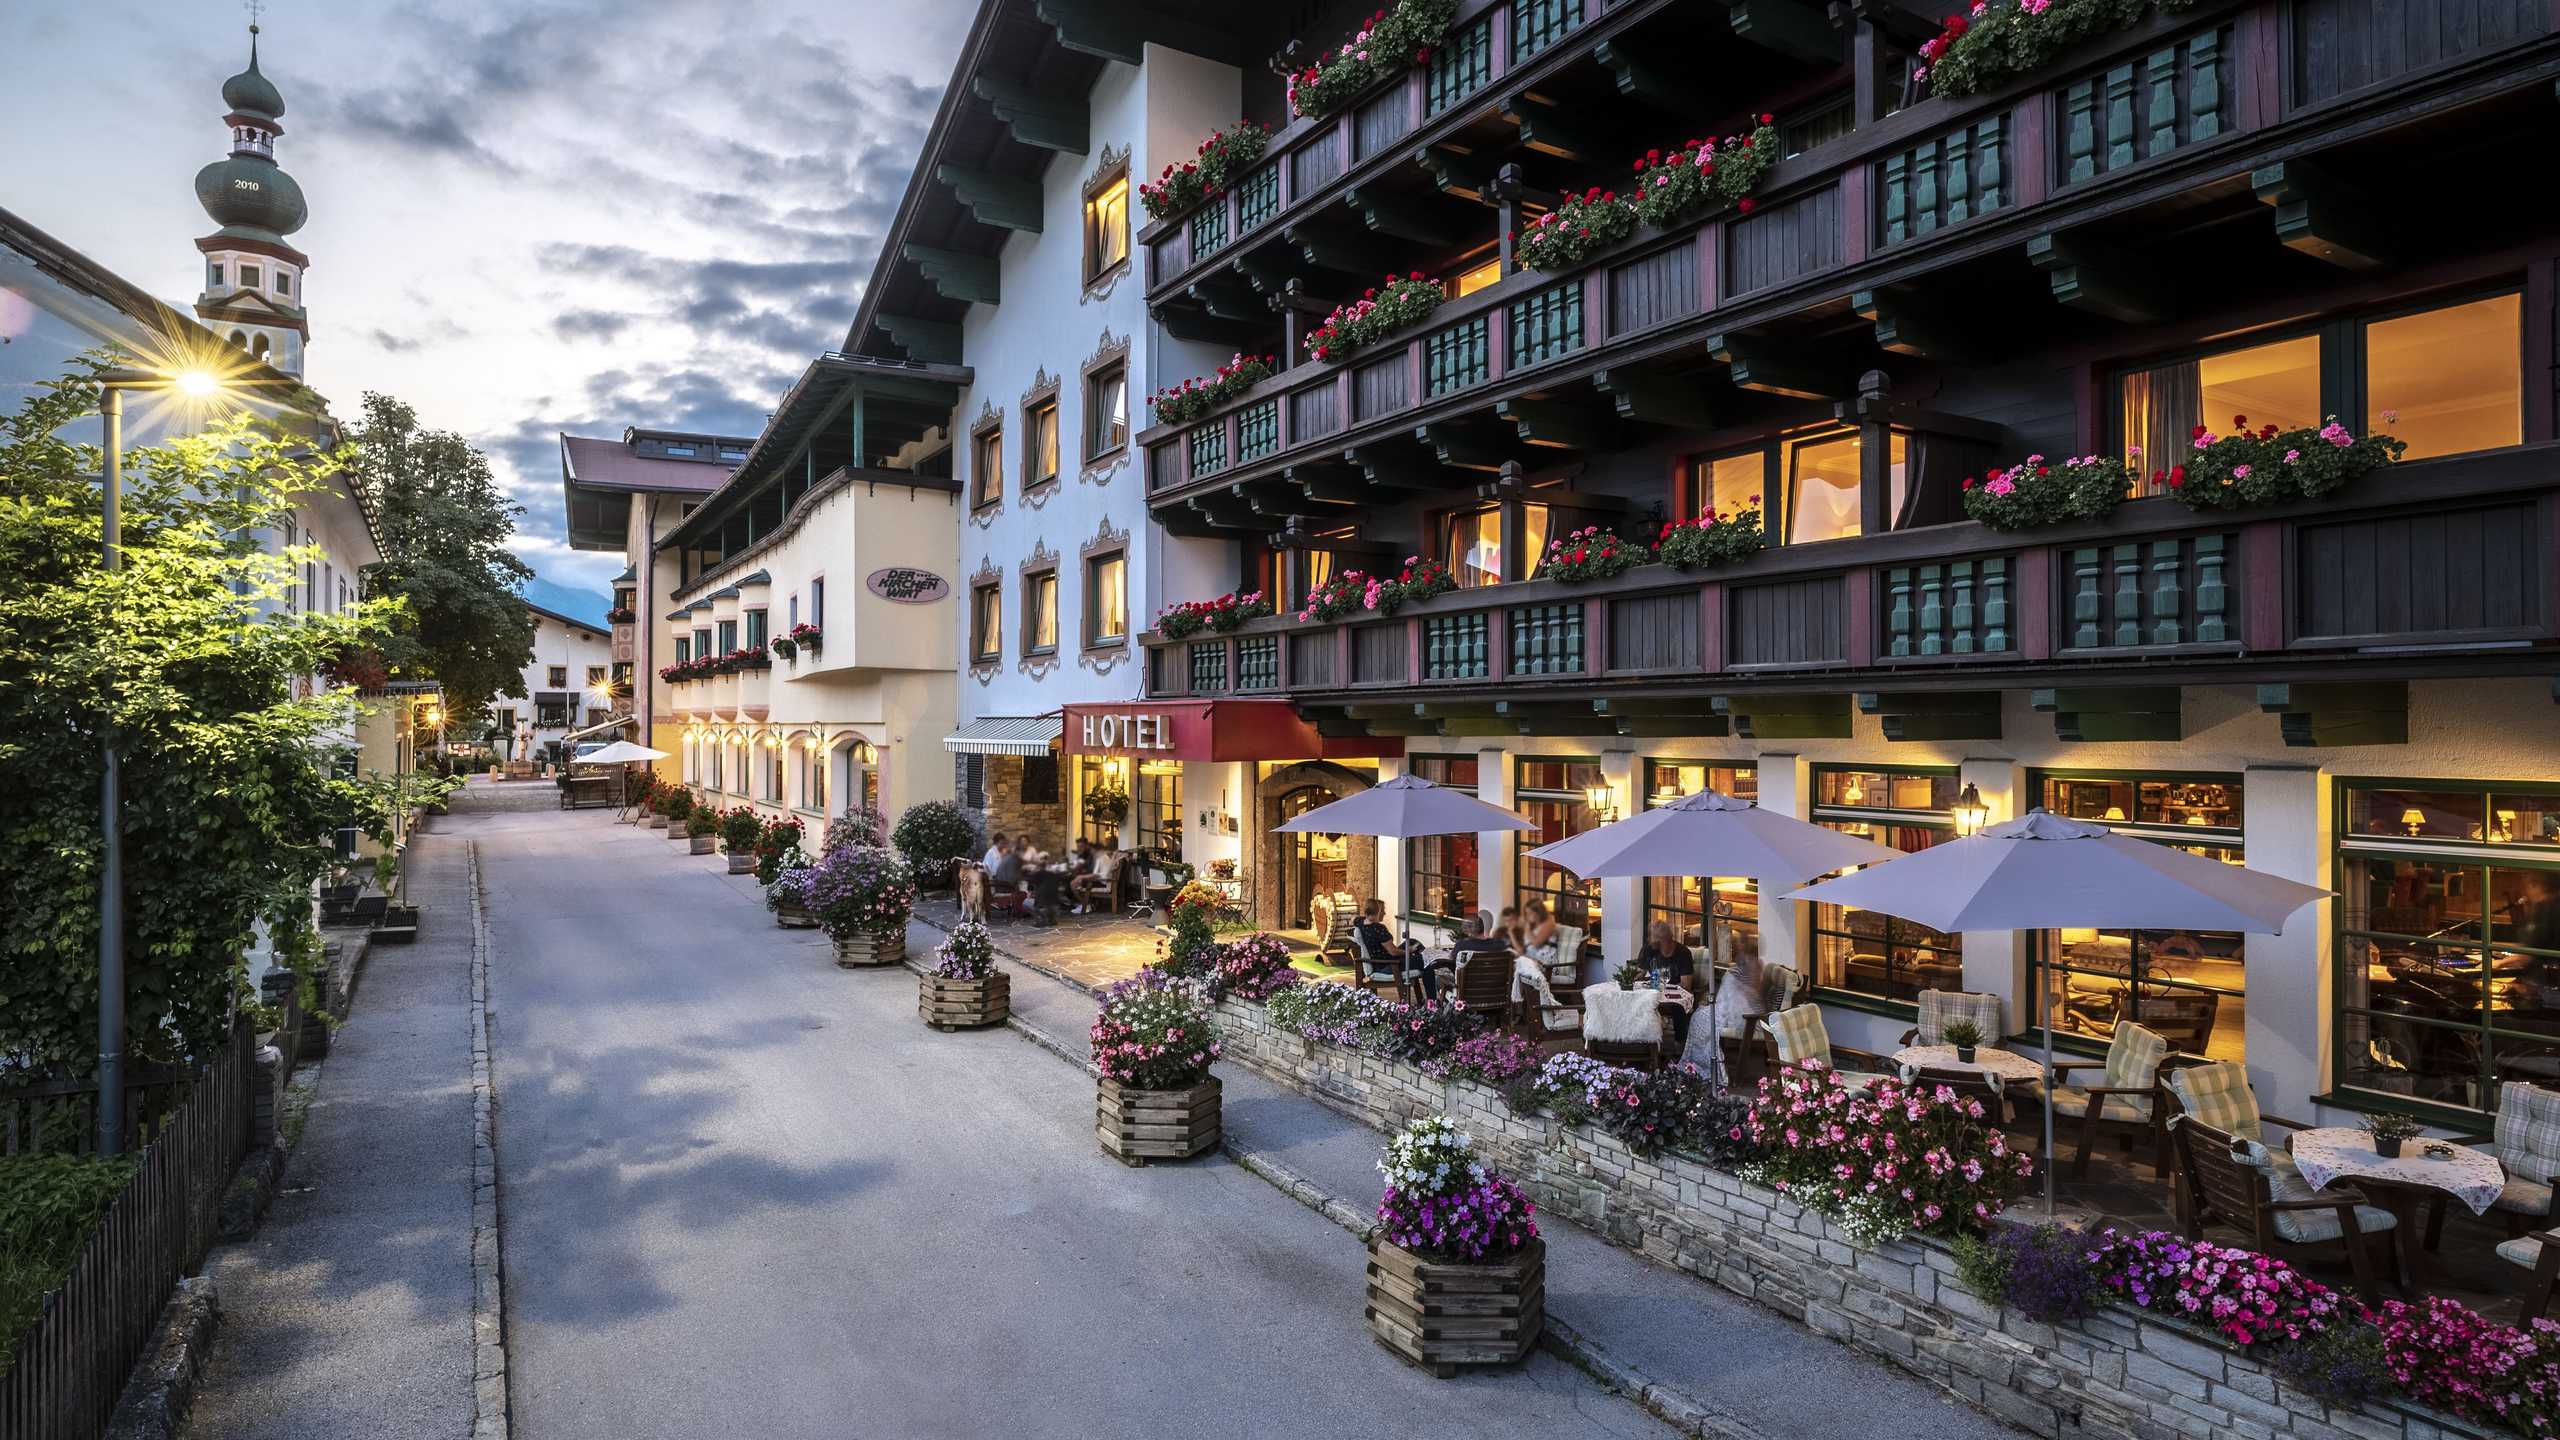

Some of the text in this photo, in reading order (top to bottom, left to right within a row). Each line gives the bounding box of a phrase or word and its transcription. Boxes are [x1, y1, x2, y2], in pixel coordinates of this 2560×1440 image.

[234, 179, 259, 191] 2010
[887, 569, 916, 580] DER
[878, 578, 939, 591] KIRCHEN
[886, 588, 922, 599] WIRT
[1083, 714, 1172, 749] HOTEL
